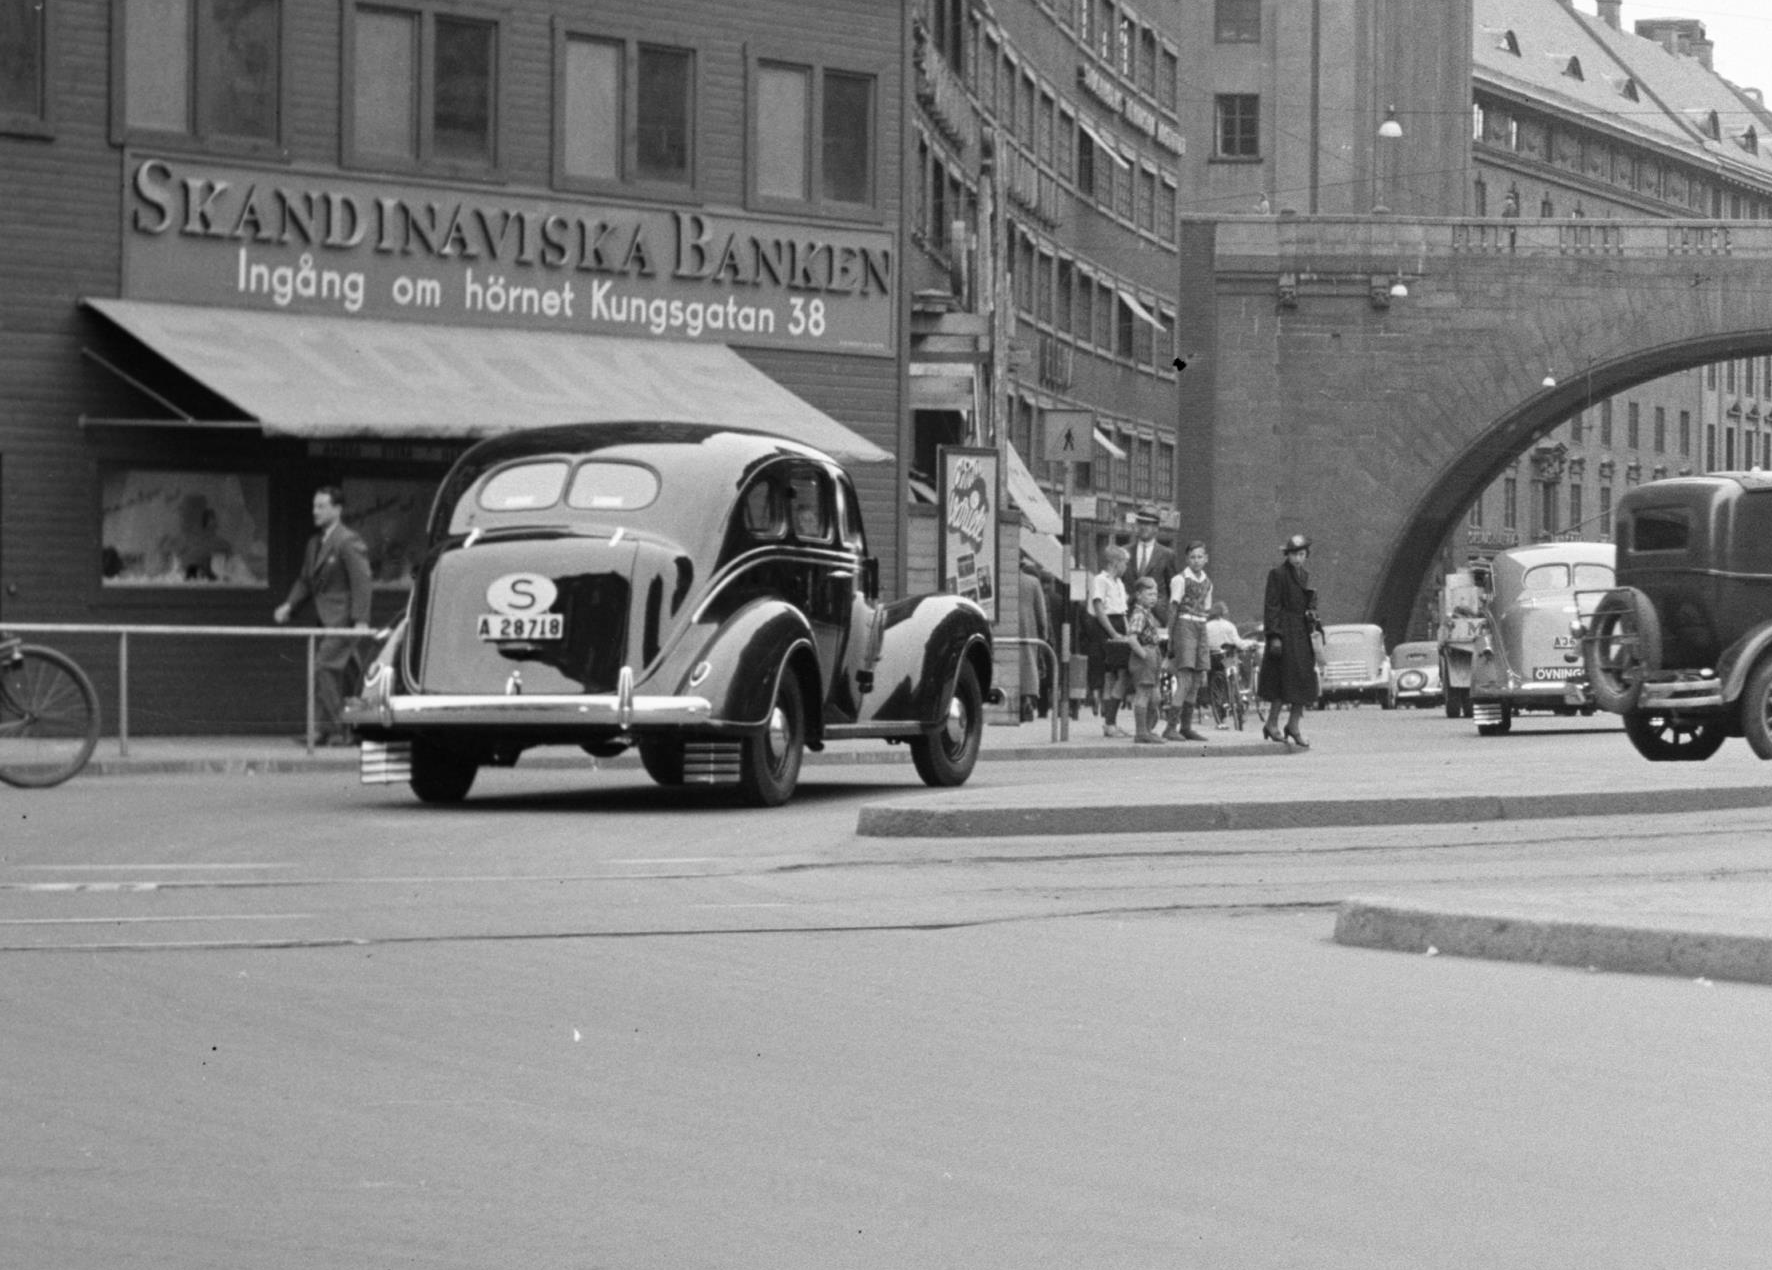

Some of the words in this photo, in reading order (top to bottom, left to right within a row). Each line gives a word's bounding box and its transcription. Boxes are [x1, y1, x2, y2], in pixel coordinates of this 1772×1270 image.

[133, 159, 657, 280] SKANDINAVISKA
[670, 210, 890, 298] BANKEN
[238, 247, 365, 311] Ingång
[392, 276, 441, 307] om
[465, 268, 574, 318] hörnet
[591, 280, 775, 336] Kungsgatan
[788, 297, 826, 337] 38
[507, 579, 536, 610] S
[479, 618, 491, 637] A
[500, 618, 561, 638] 28718
